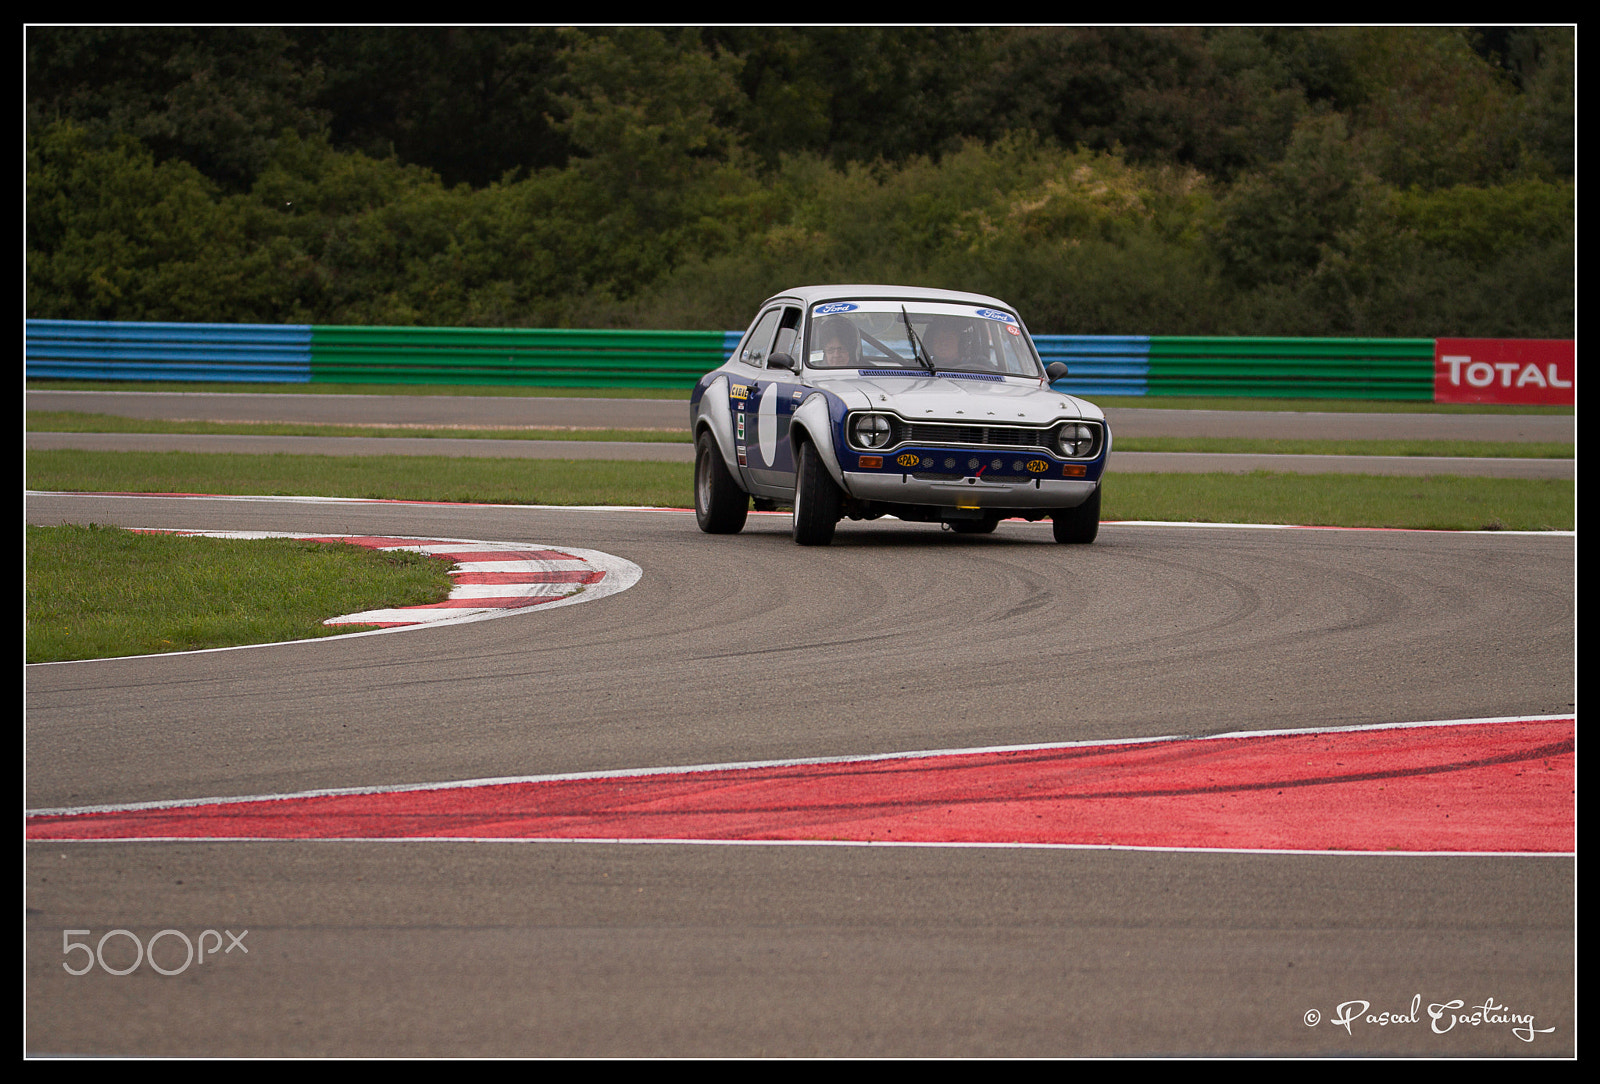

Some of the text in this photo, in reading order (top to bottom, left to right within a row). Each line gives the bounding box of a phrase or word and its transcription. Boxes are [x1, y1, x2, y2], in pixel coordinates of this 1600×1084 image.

[822, 304, 850, 312] Ford
[983, 310, 1008, 321] Ford
[1442, 355, 1572, 388] TOTAL
[899, 455, 918, 466] SPAX
[1028, 460, 1047, 472] SPAX
